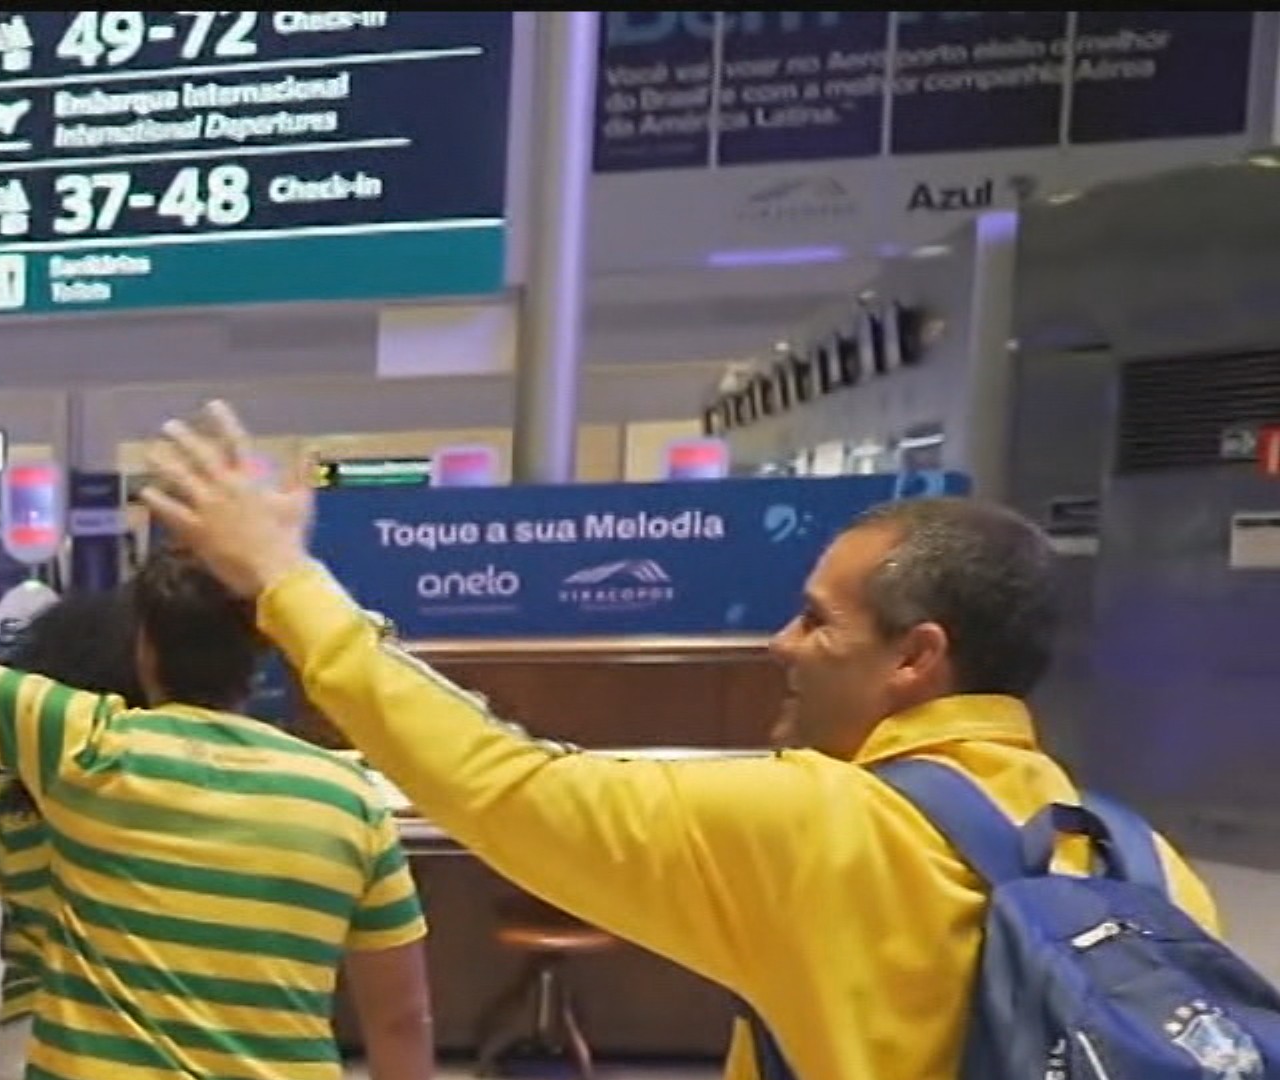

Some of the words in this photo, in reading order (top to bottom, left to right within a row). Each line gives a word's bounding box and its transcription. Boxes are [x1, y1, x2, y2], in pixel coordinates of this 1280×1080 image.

[56, 11, 257, 66] 49-72
[54, 87, 179, 118] Embarque
[182, 72, 350, 108] Internacional
[54, 114, 203, 148] International
[204, 110, 338, 142] Departures
[53, 165, 249, 234] 37-48
[269, 172, 383, 202] Check-in
[906, 179, 994, 212] Azul
[374, 518, 479, 550] Toque
[484, 521, 509, 544] a
[513, 519, 578, 544] sua
[583, 510, 726, 541] Melodia
[416, 564, 521, 599] anelo
